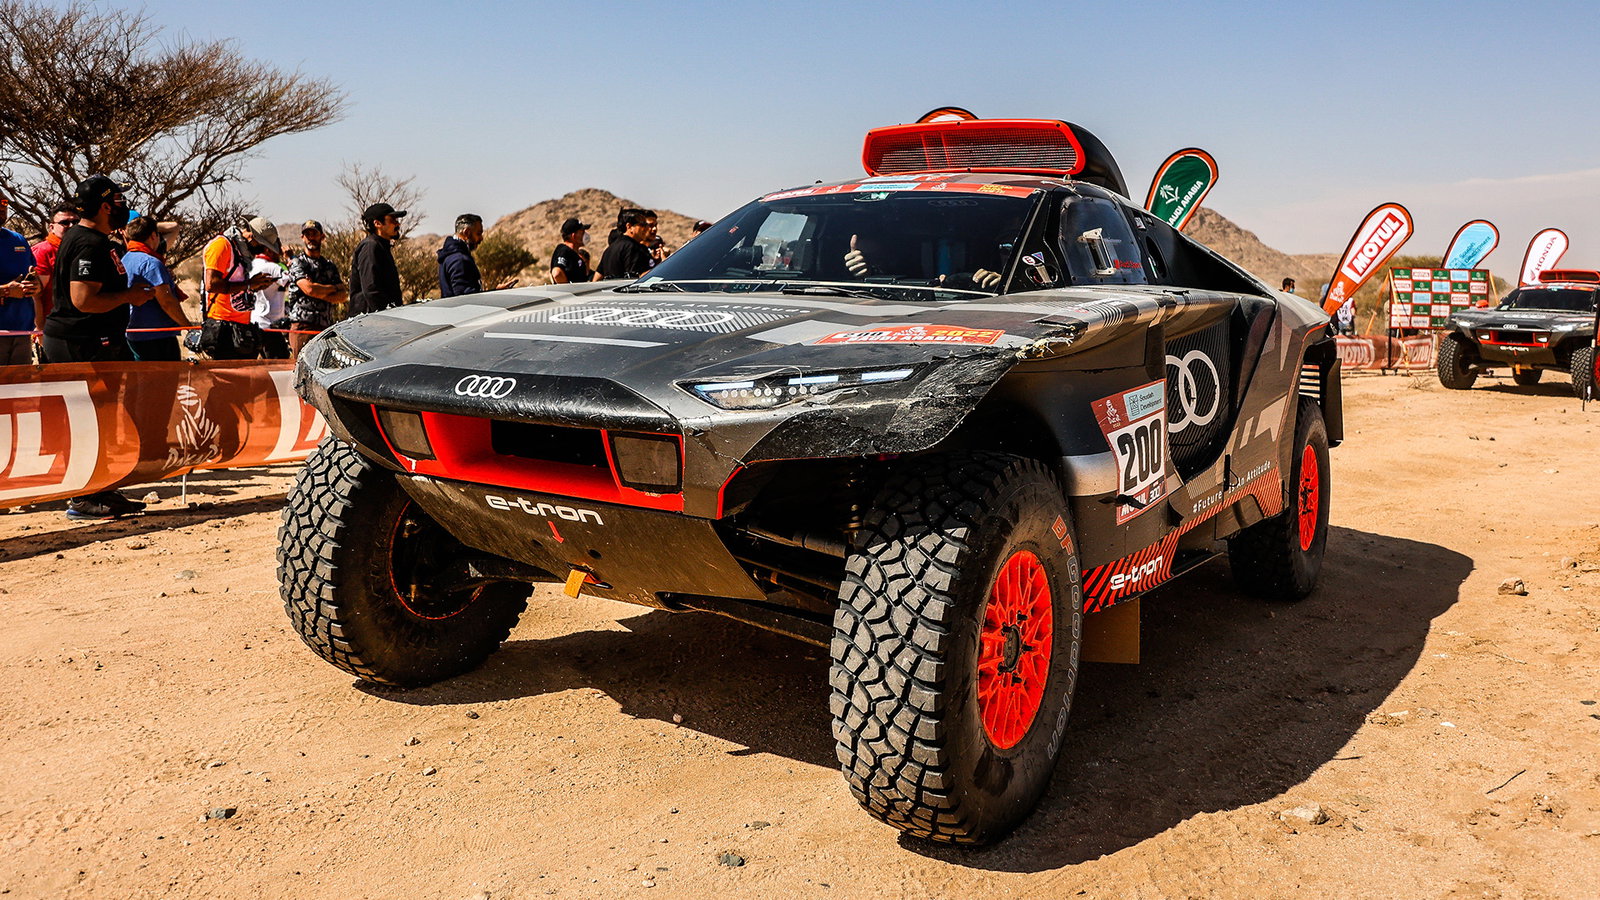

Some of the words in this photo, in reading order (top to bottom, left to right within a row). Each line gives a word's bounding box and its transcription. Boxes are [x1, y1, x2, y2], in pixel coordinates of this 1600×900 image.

[1180, 180, 1204, 208] ARABIA
[1351, 217, 1402, 276] MOTUL
[1535, 236, 1558, 271] HONDA
[931, 330, 994, 338] 2022
[1139, 391, 1154, 402] Soudah
[1117, 418, 1162, 492] 200
[1192, 490, 1222, 513] #Future
[1246, 460, 1271, 482] Attitude
[484, 494, 605, 526] e-tron
[1110, 555, 1163, 591] e-tron
